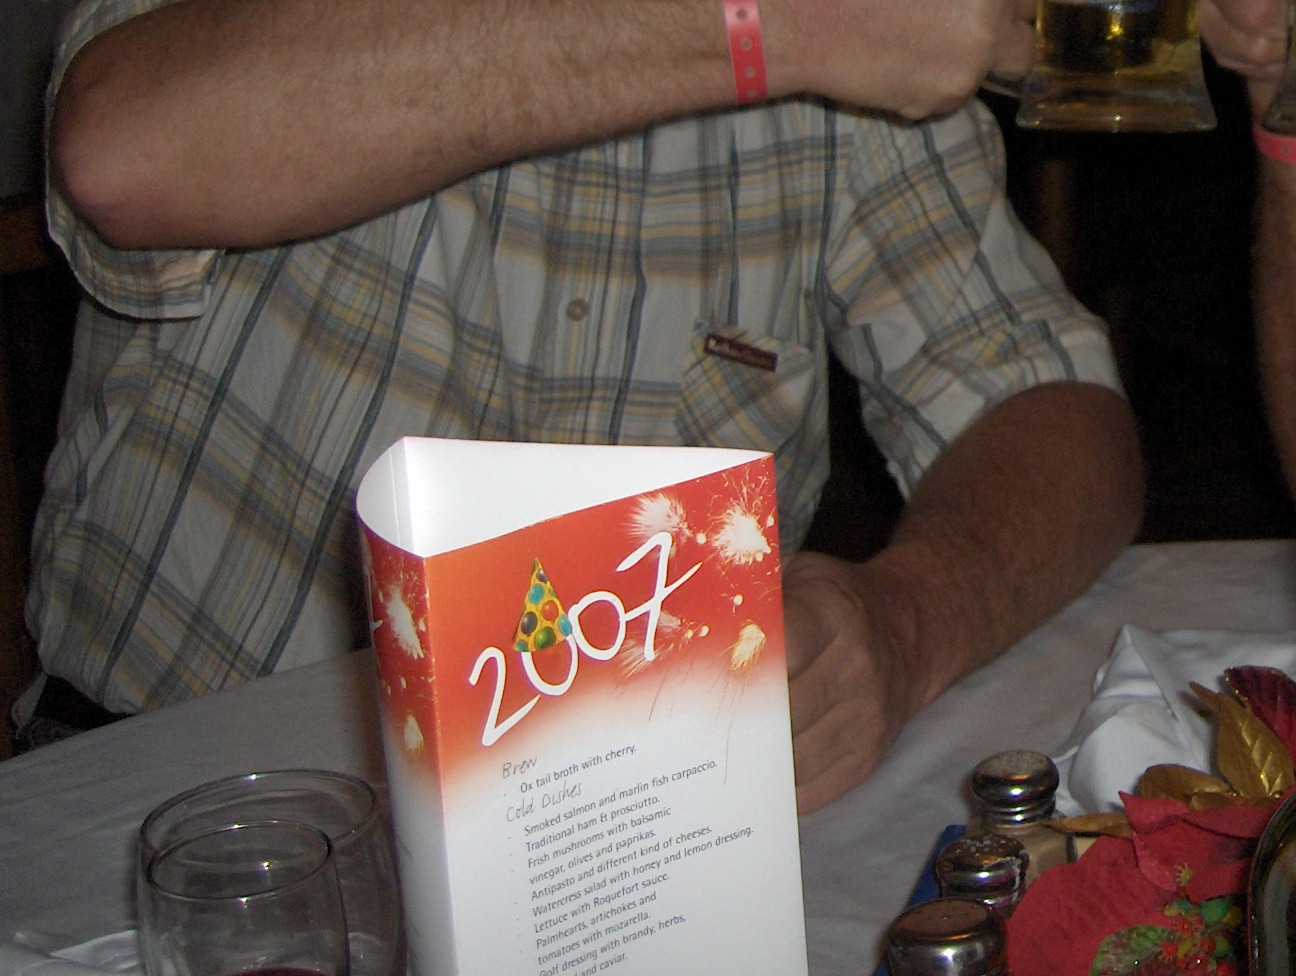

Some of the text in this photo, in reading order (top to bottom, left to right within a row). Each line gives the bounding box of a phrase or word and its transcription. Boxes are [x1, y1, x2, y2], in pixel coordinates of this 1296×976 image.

[469, 532, 702, 746] 2007
[502, 756, 537, 779] Brew
[520, 745, 637, 793] Ox tail broth with cherry.
[506, 780, 582, 822] Cold Dishes
[524, 759, 717, 836] Smoked salmon and marlin fish carpaccio.
[525, 824, 575, 852] Traditional
[577, 818, 598, 832] ham
[610, 796, 660, 821] prosciutto.
[528, 806, 672, 868] Frish mushrooms with balsamic
[531, 826, 713, 901] Antipasto and different kind of cheeses.
[568, 852, 594, 869] olives
[595, 843, 613, 858] and
[615, 829, 657, 852] paprikas.
[532, 826, 754, 917] Watercress salad with honey and lemon dressing.
[534, 873, 670, 933] Lettuce with Roquefort sauce.
[590, 900, 637, 926] artichokes
[639, 891, 657, 906] and
[538, 911, 651, 965] tomatoes with mozarella.
[561, 949, 598, 972] dressing
[600, 938, 621, 953] with
[599, 953, 628, 971] caviar.
